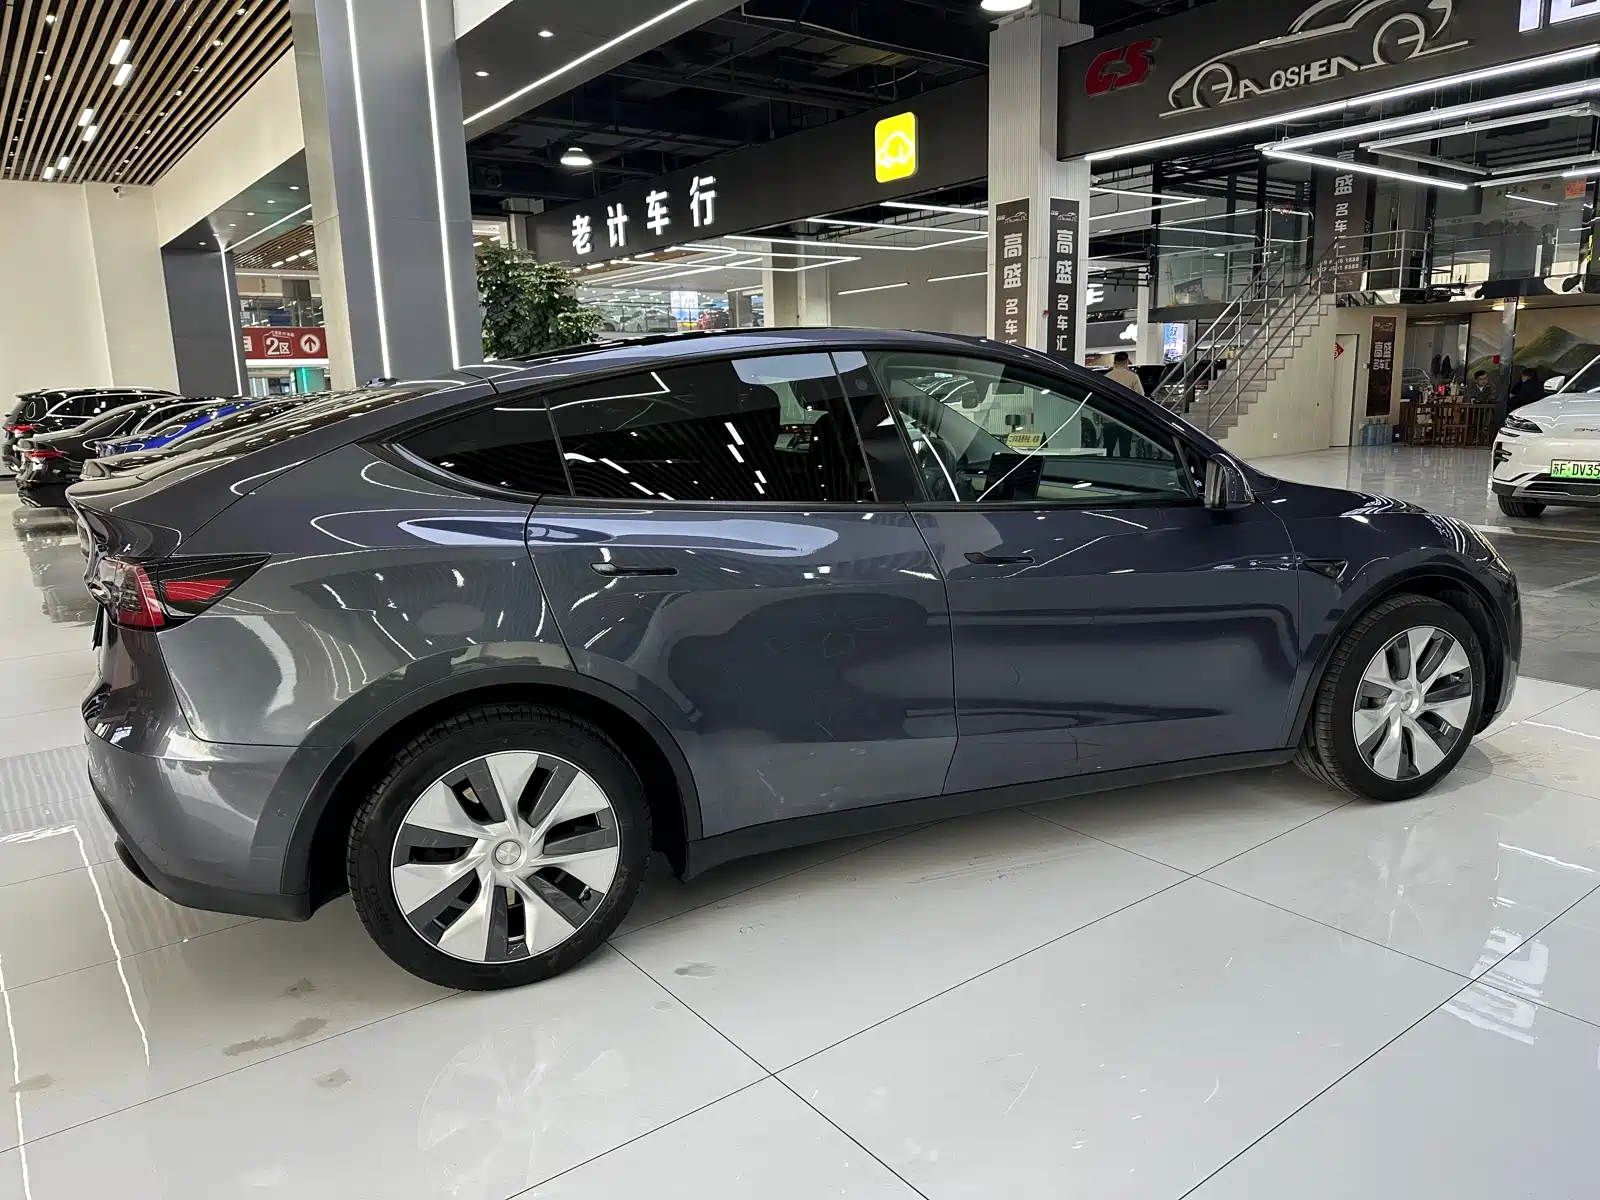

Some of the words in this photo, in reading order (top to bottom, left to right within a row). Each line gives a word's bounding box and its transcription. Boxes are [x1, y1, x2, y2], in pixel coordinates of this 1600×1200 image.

[571, 175, 717, 255] 老计车行
[1055, 229, 1074, 352] 高盛名车汇
[266, 337, 290, 355] 2区
